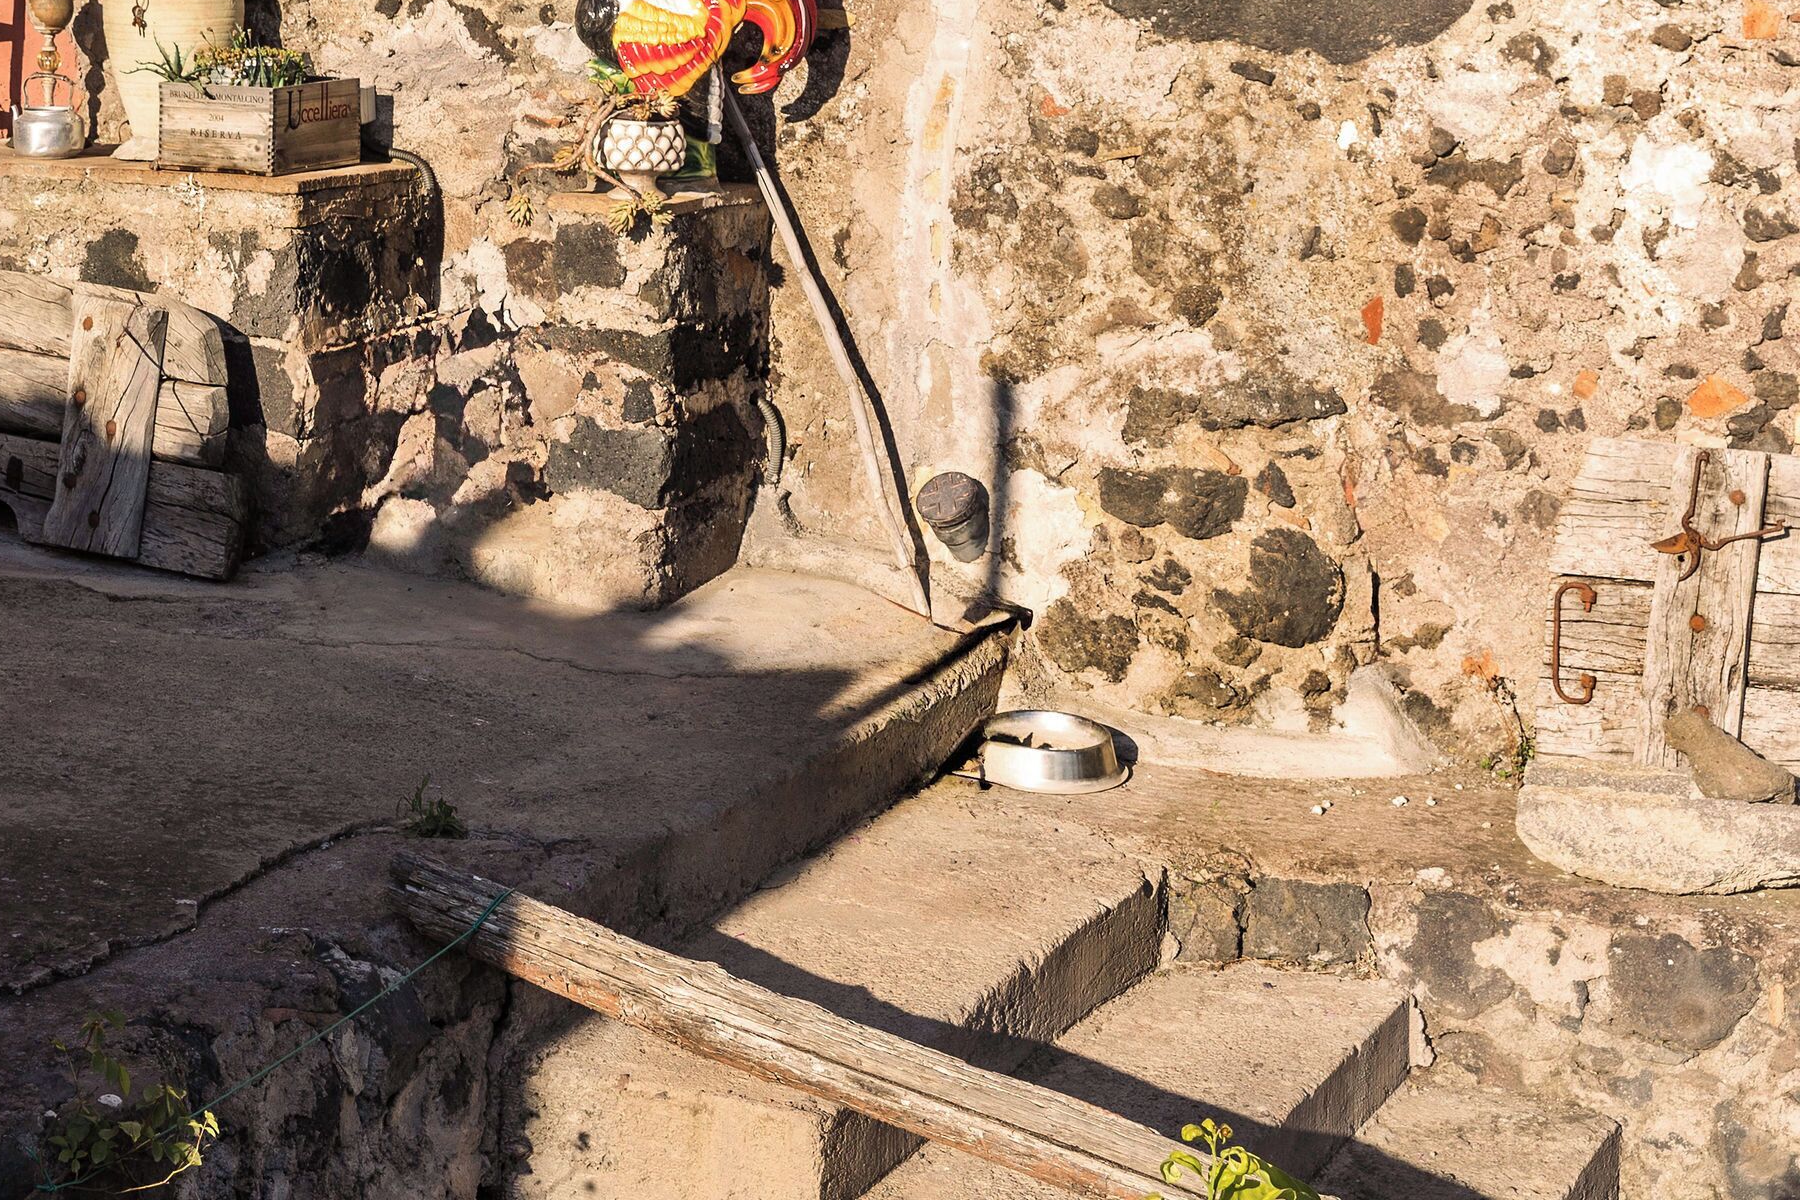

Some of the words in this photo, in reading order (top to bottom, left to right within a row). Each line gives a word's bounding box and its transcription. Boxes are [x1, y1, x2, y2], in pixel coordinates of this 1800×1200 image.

[215, 92, 264, 104] MONTALCINO
[285, 83, 349, 132] Uccelliera
[208, 113, 224, 122] 2004
[190, 127, 241, 140] RISERVA
